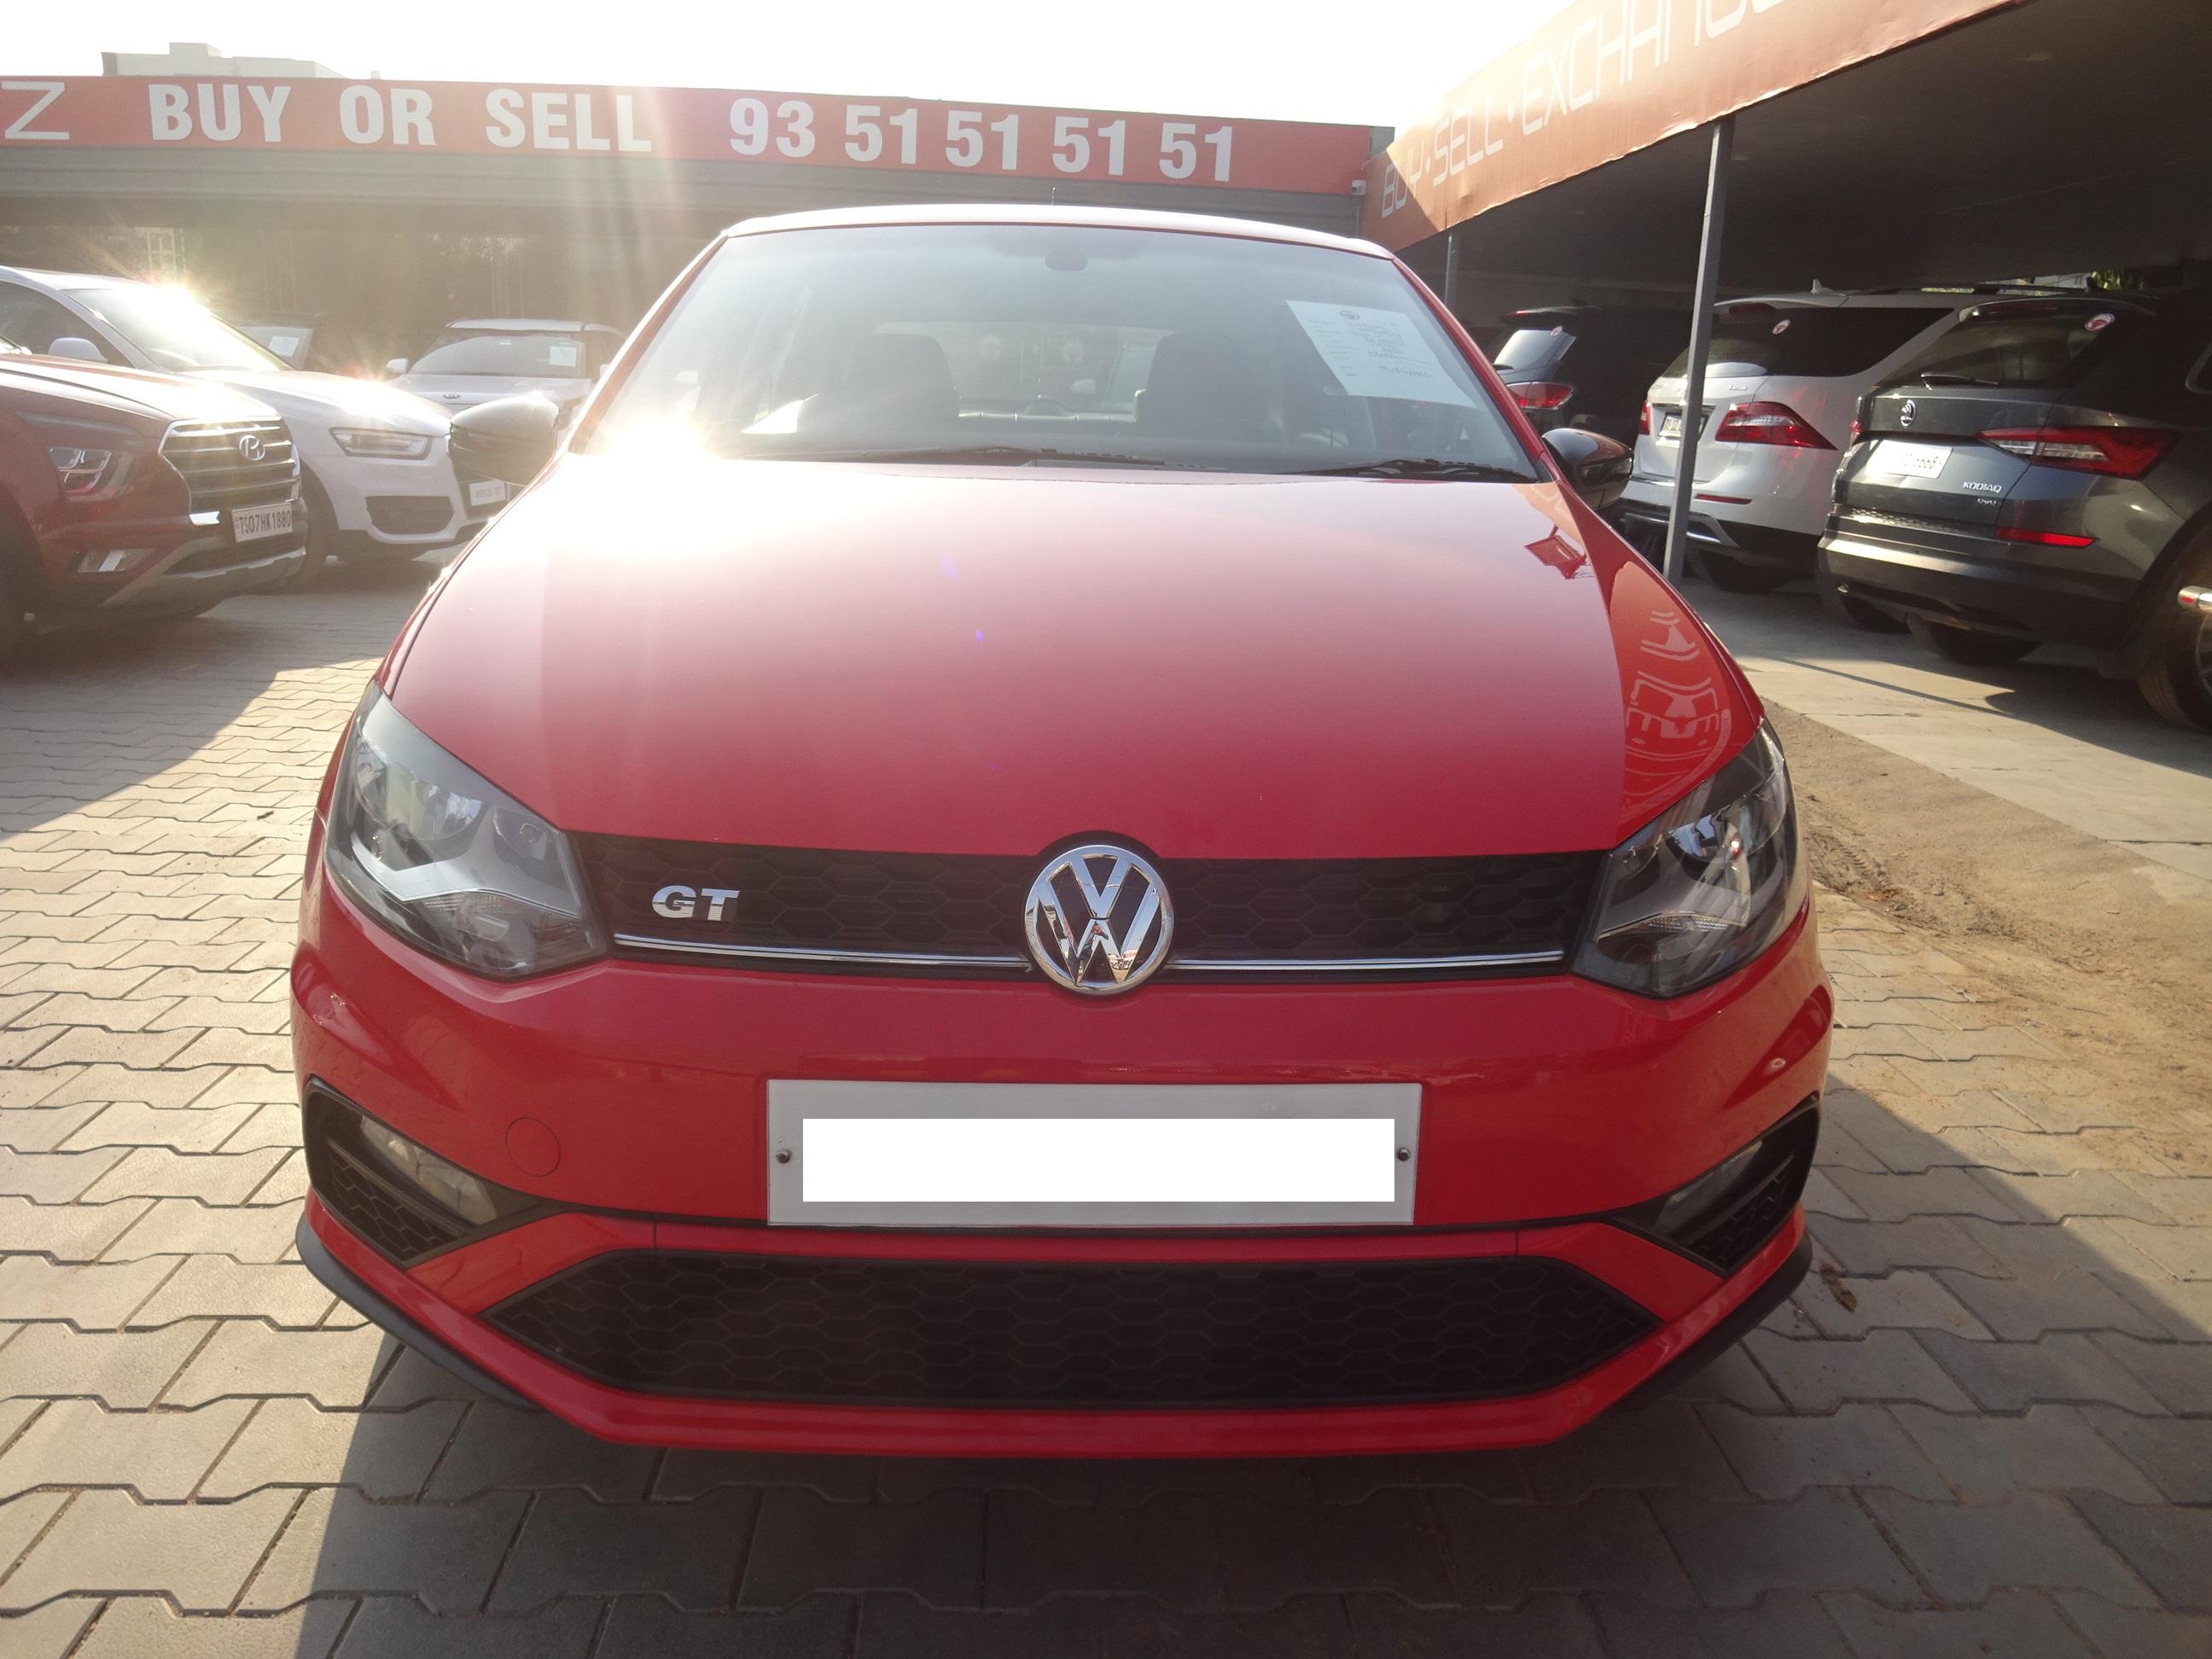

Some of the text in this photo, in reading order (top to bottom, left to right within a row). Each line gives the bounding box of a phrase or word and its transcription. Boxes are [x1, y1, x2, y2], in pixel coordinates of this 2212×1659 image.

[148, 84, 652, 153] BUY OR SELL
[729, 97, 1234, 183] 93 51 51 51 51
[1382, 0, 1785, 218] BUY SELL EXCHA
[1963, 481, 2002, 494] KODIAQ
[651, 884, 740, 922] GT
